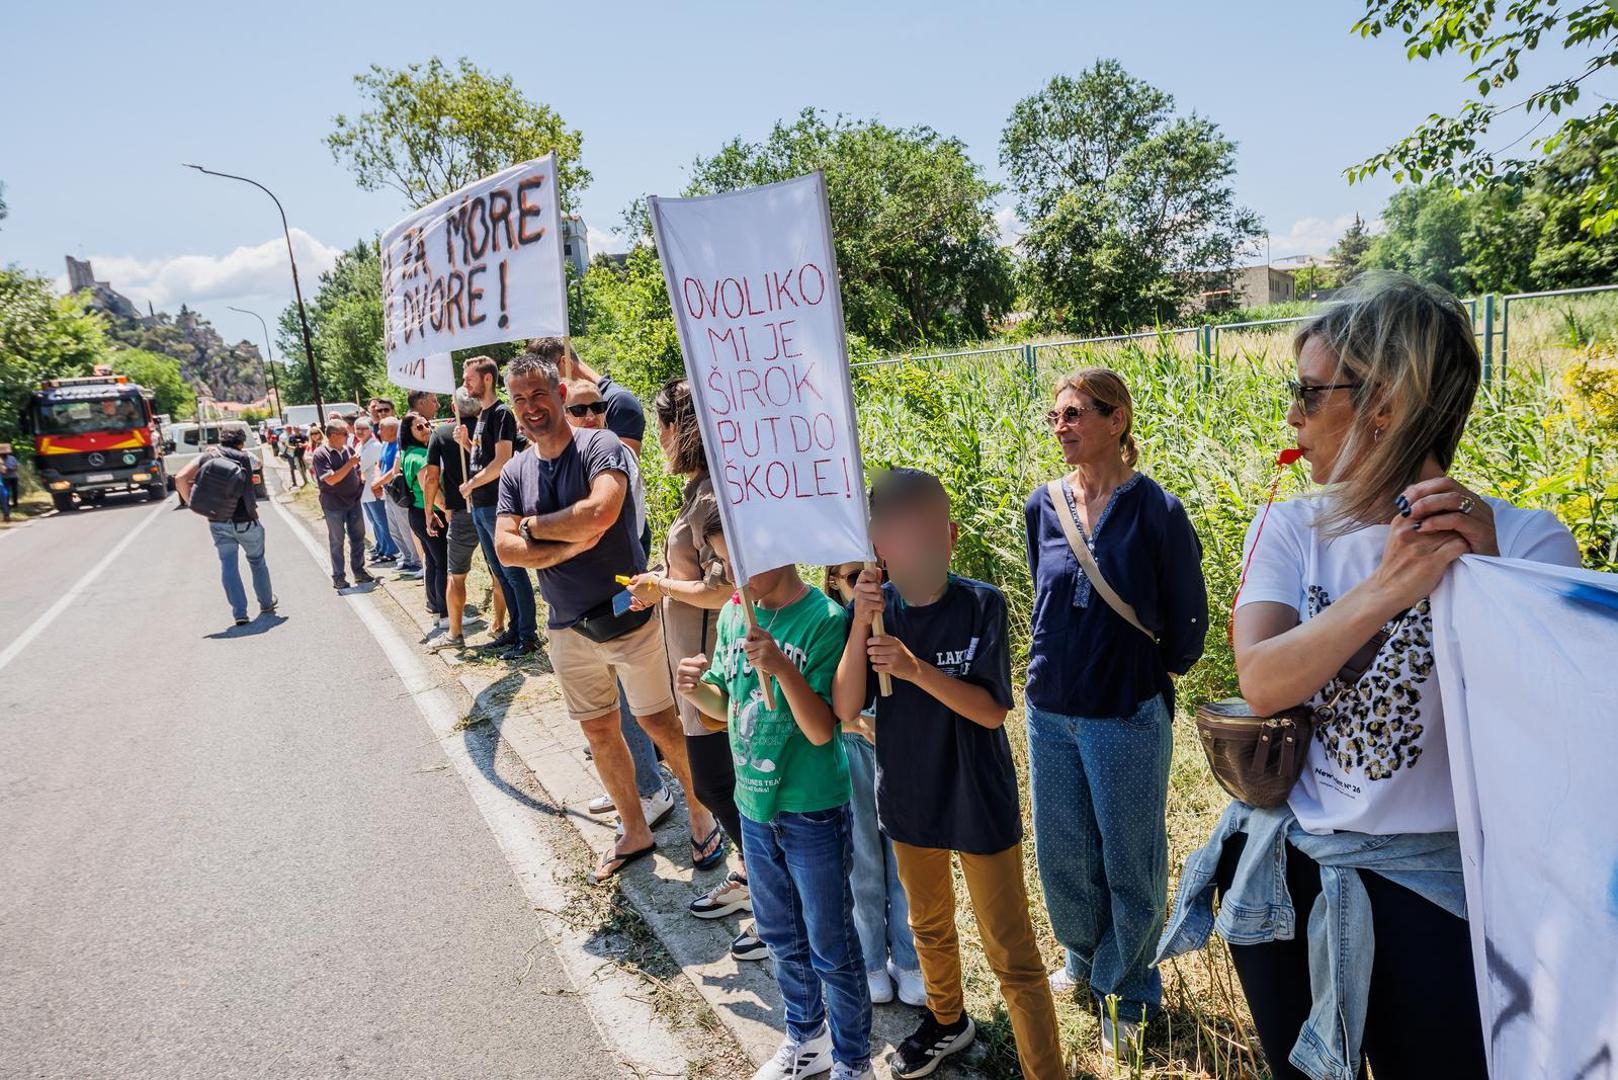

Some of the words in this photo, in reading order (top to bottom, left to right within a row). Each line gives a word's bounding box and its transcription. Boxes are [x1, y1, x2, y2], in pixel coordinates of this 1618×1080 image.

[446, 174, 545, 268] MORE
[683, 262, 825, 320] OVOLIKO
[707, 325, 751, 363] MI
[763, 319, 804, 362] JE
[707, 361, 825, 416] ŠIROK
[716, 415, 781, 460] PUT
[789, 411, 836, 454] DO
[722, 456, 852, 506] ŠKOLE!
